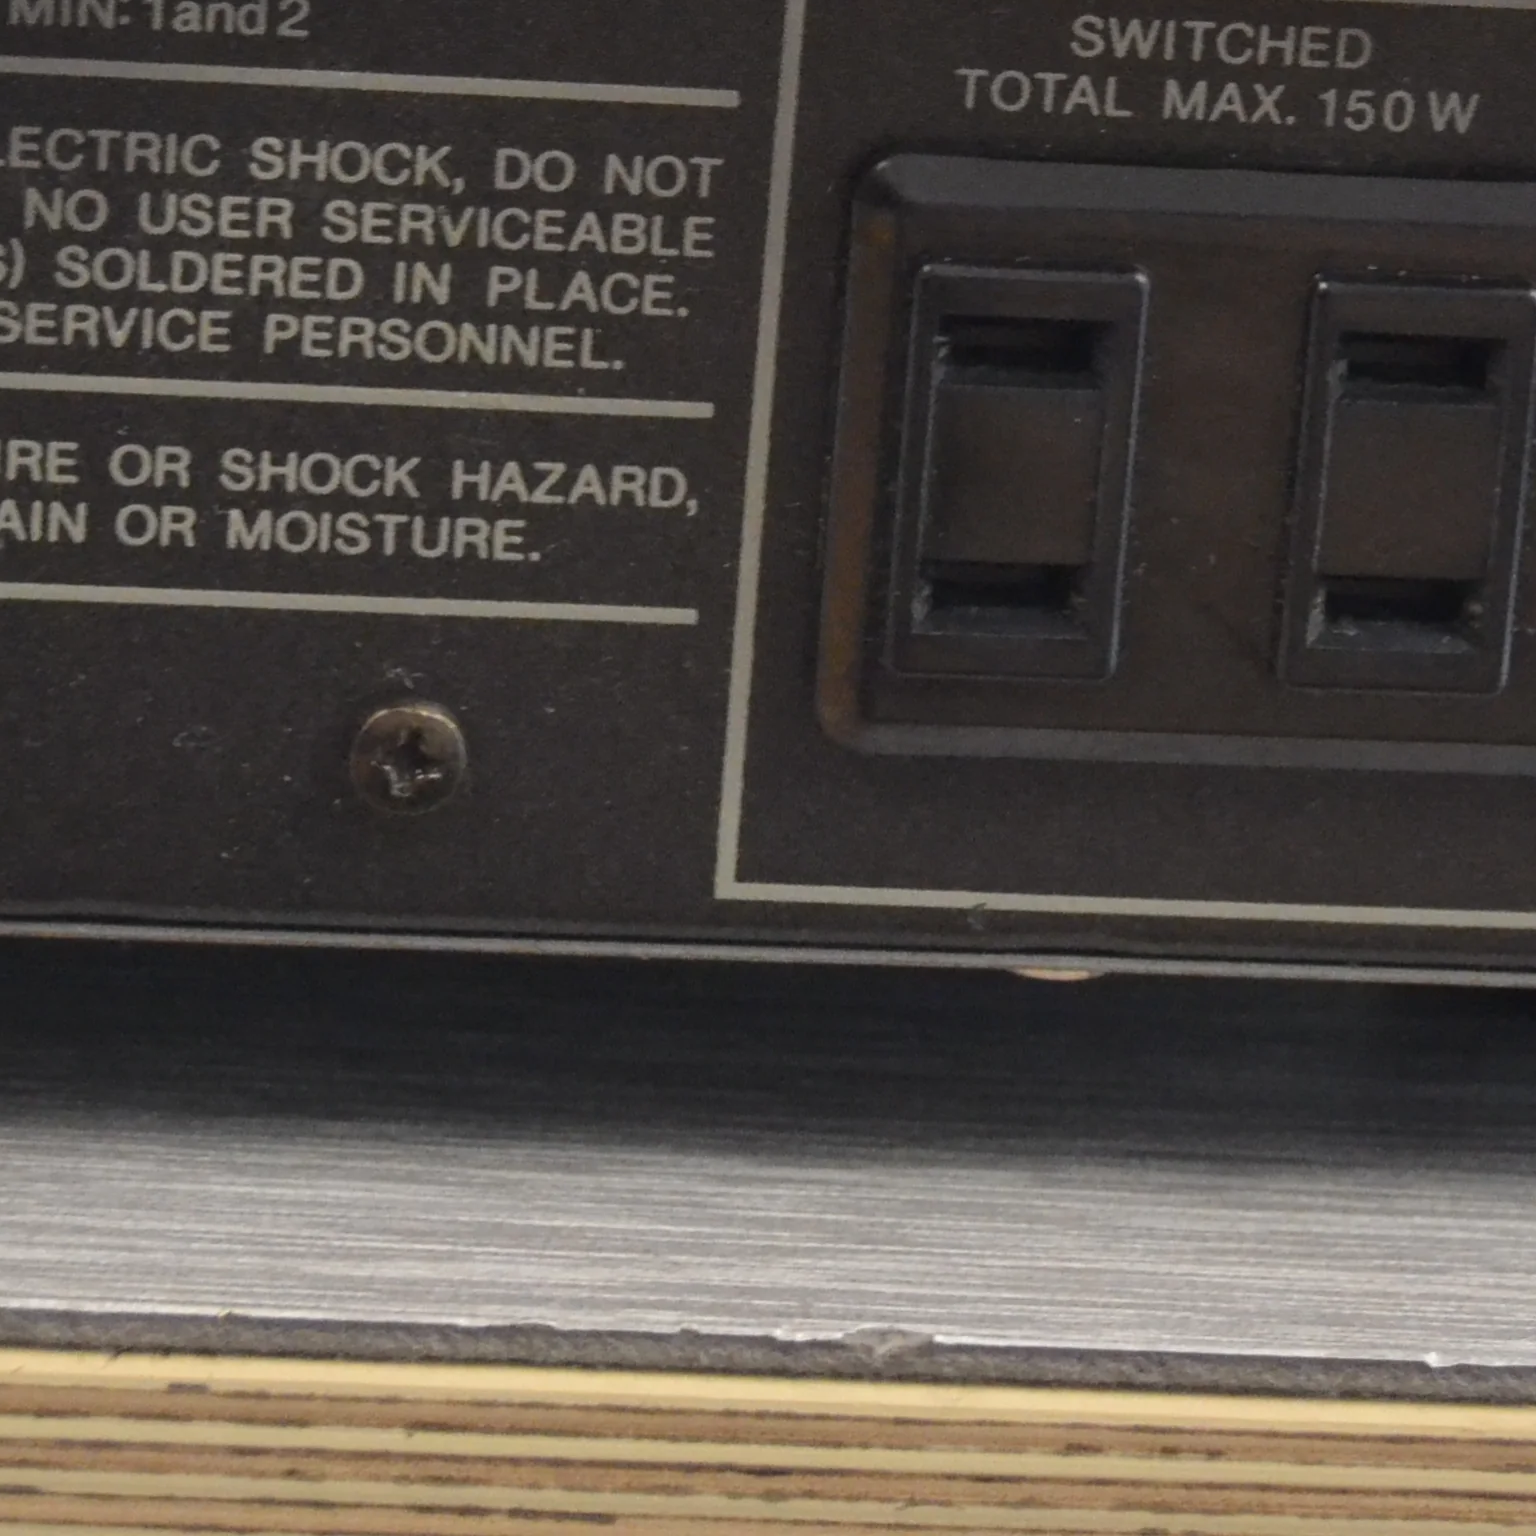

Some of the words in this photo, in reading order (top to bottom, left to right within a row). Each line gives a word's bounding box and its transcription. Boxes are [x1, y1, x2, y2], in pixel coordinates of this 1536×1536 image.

[1070, 15, 1372, 69] SWITCHED
[957, 68, 1132, 118] TOTAL
[1160, 77, 1296, 126] MAX.
[250, 138, 466, 193] SHOCK,
[496, 150, 574, 190] DO
[605, 154, 723, 199] NOT
[25, 189, 107, 232] NO
[138, 193, 293, 241] USER
[322, 202, 714, 258] SERVICEABLE
[55, 249, 364, 303] SOLDERED
[394, 264, 449, 304] IN
[487, 268, 689, 318] PLACE.
[264, 316, 623, 372] PERSONNEL.
[110, 445, 191, 489] OR
[220, 450, 421, 499] SHOCK
[452, 462, 698, 517] HAZARD,
[116, 505, 196, 549] OR
[227, 511, 541, 562] MOISTURE.
